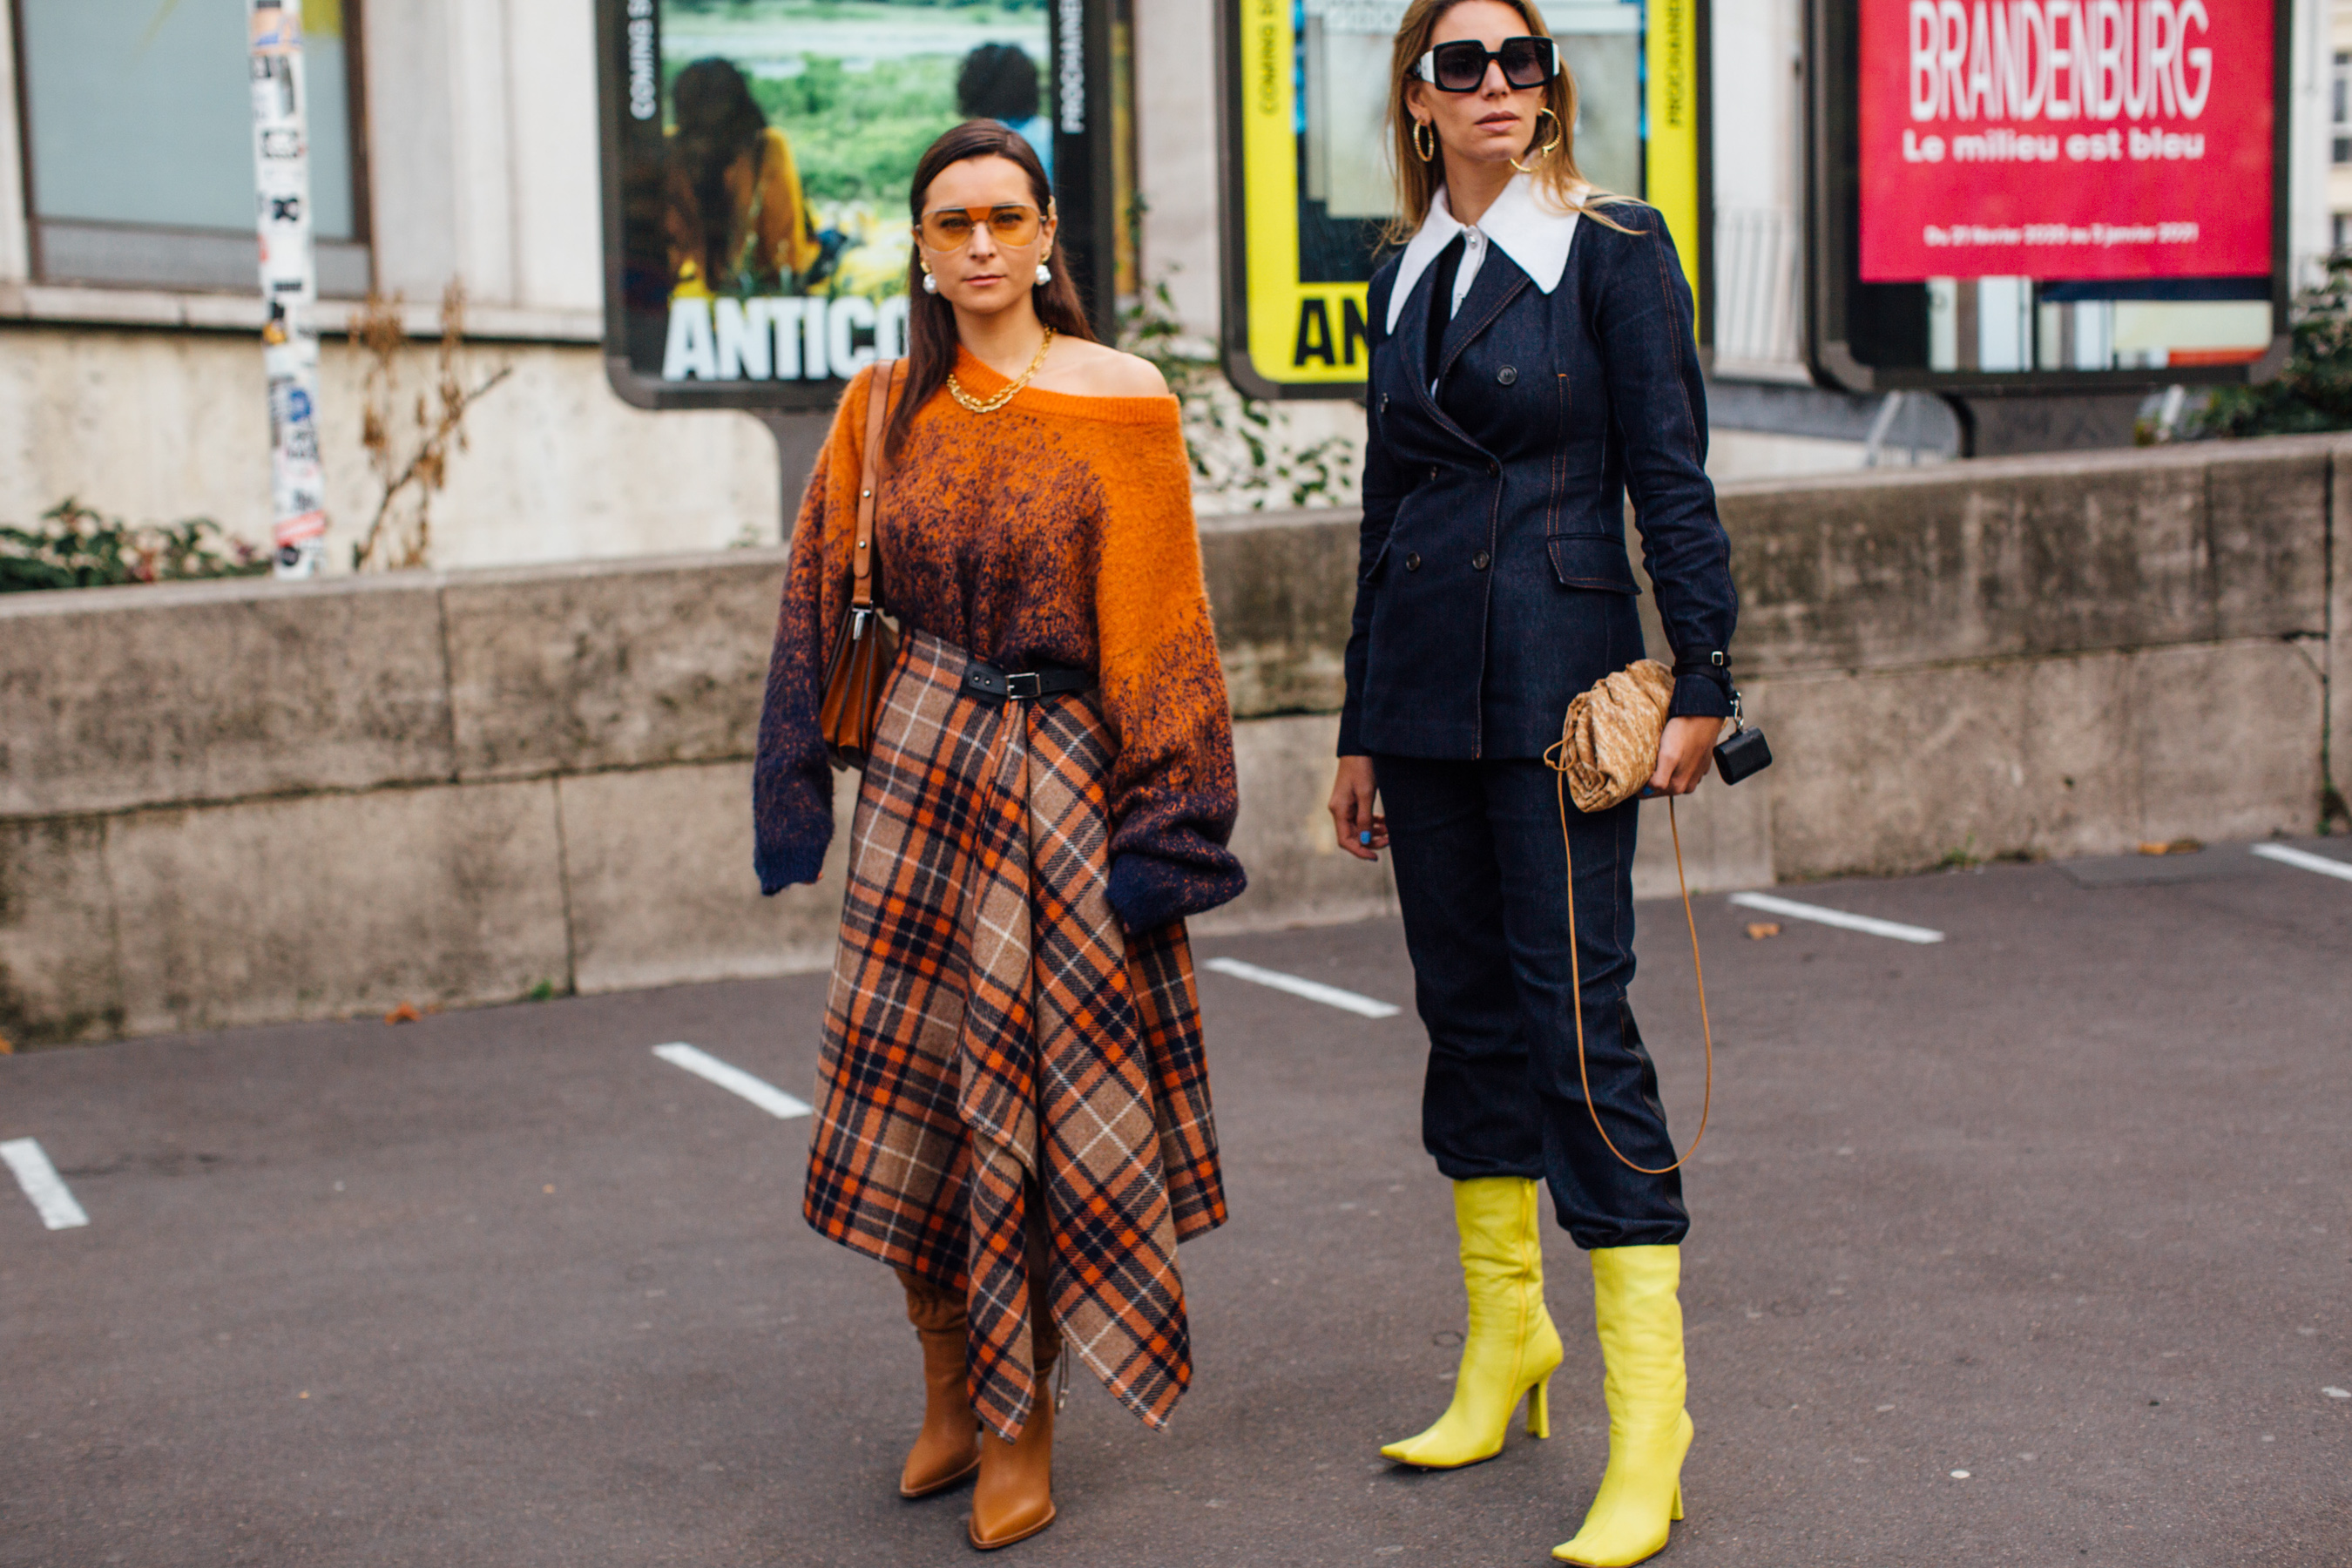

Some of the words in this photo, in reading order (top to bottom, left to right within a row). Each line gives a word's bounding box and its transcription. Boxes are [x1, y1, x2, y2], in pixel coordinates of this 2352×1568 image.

[629, 17, 657, 120] COMING
[1058, 0, 1085, 134] PROCHAINE
[1257, 24, 1280, 116] COMING
[1909, 0, 2213, 122] BRANDENBURG
[1903, 128, 1946, 163] Le
[1952, 128, 2059, 162] milieu
[2065, 128, 2123, 161] est
[2128, 126, 2206, 160] bleu
